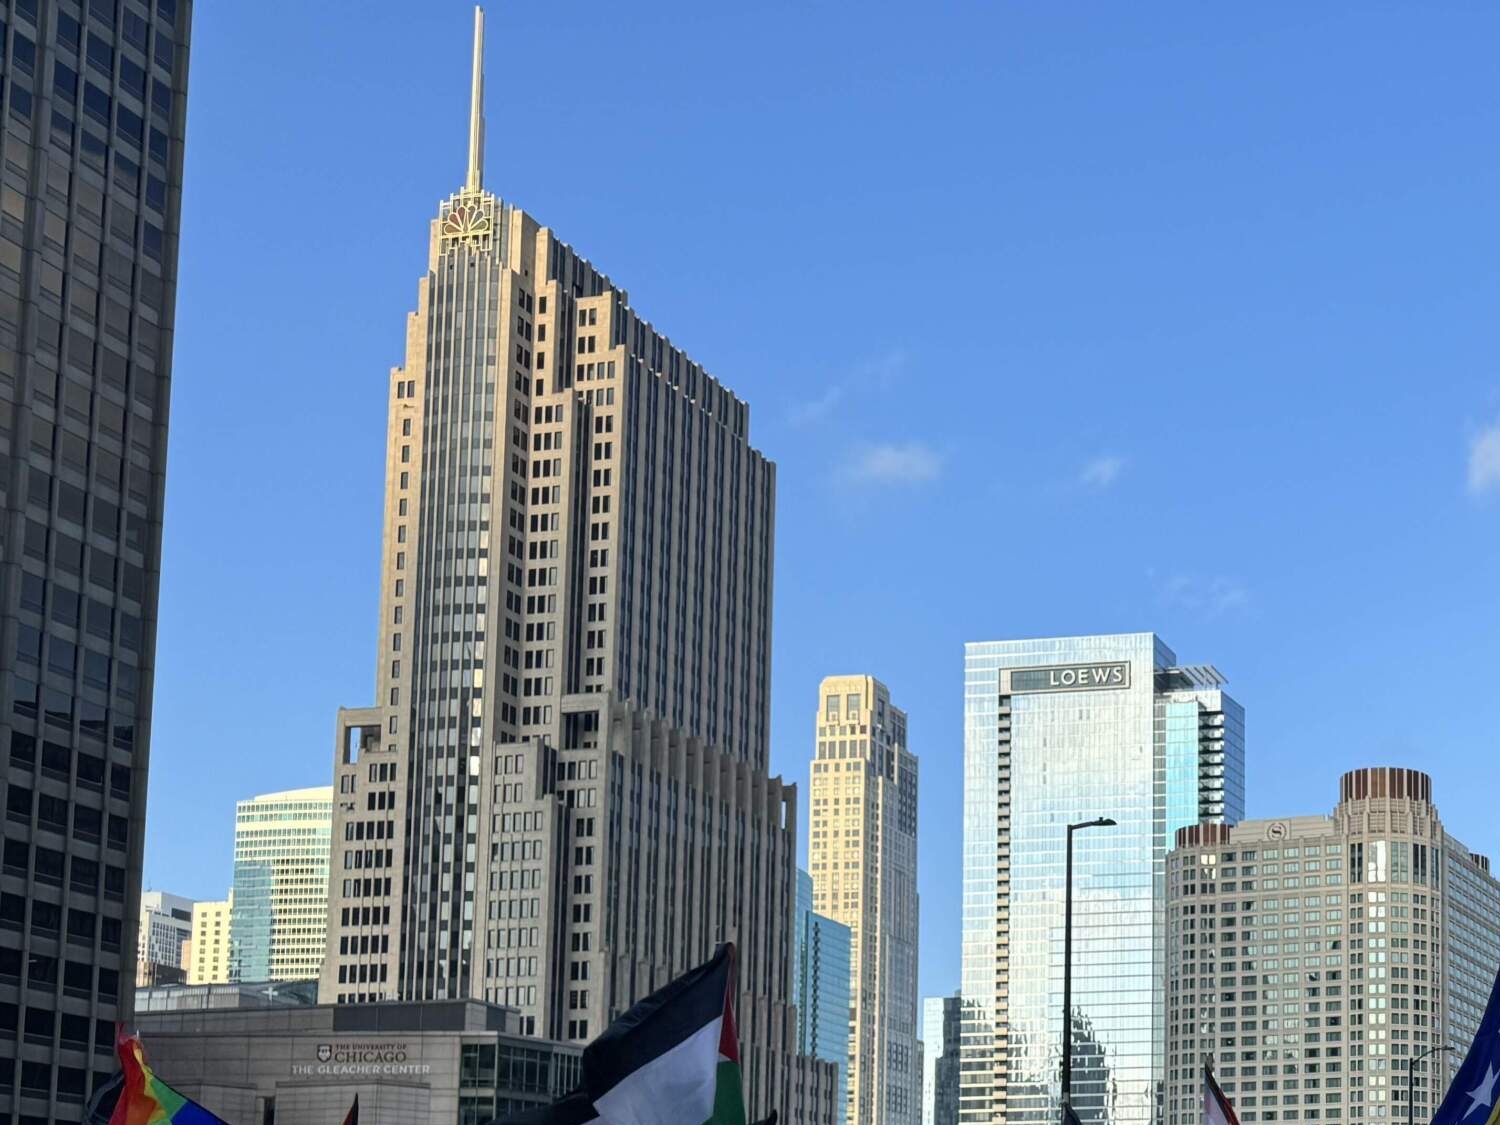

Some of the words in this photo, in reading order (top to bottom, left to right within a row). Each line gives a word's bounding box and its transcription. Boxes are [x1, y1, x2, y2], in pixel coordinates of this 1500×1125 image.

[1050, 667, 1123, 686] LOEWS
[334, 1050, 407, 1063] CHICAGO
[292, 1065, 314, 1075] THE
[317, 1065, 380, 1074] GLEACHER
[383, 1065, 430, 1074] CENTER
